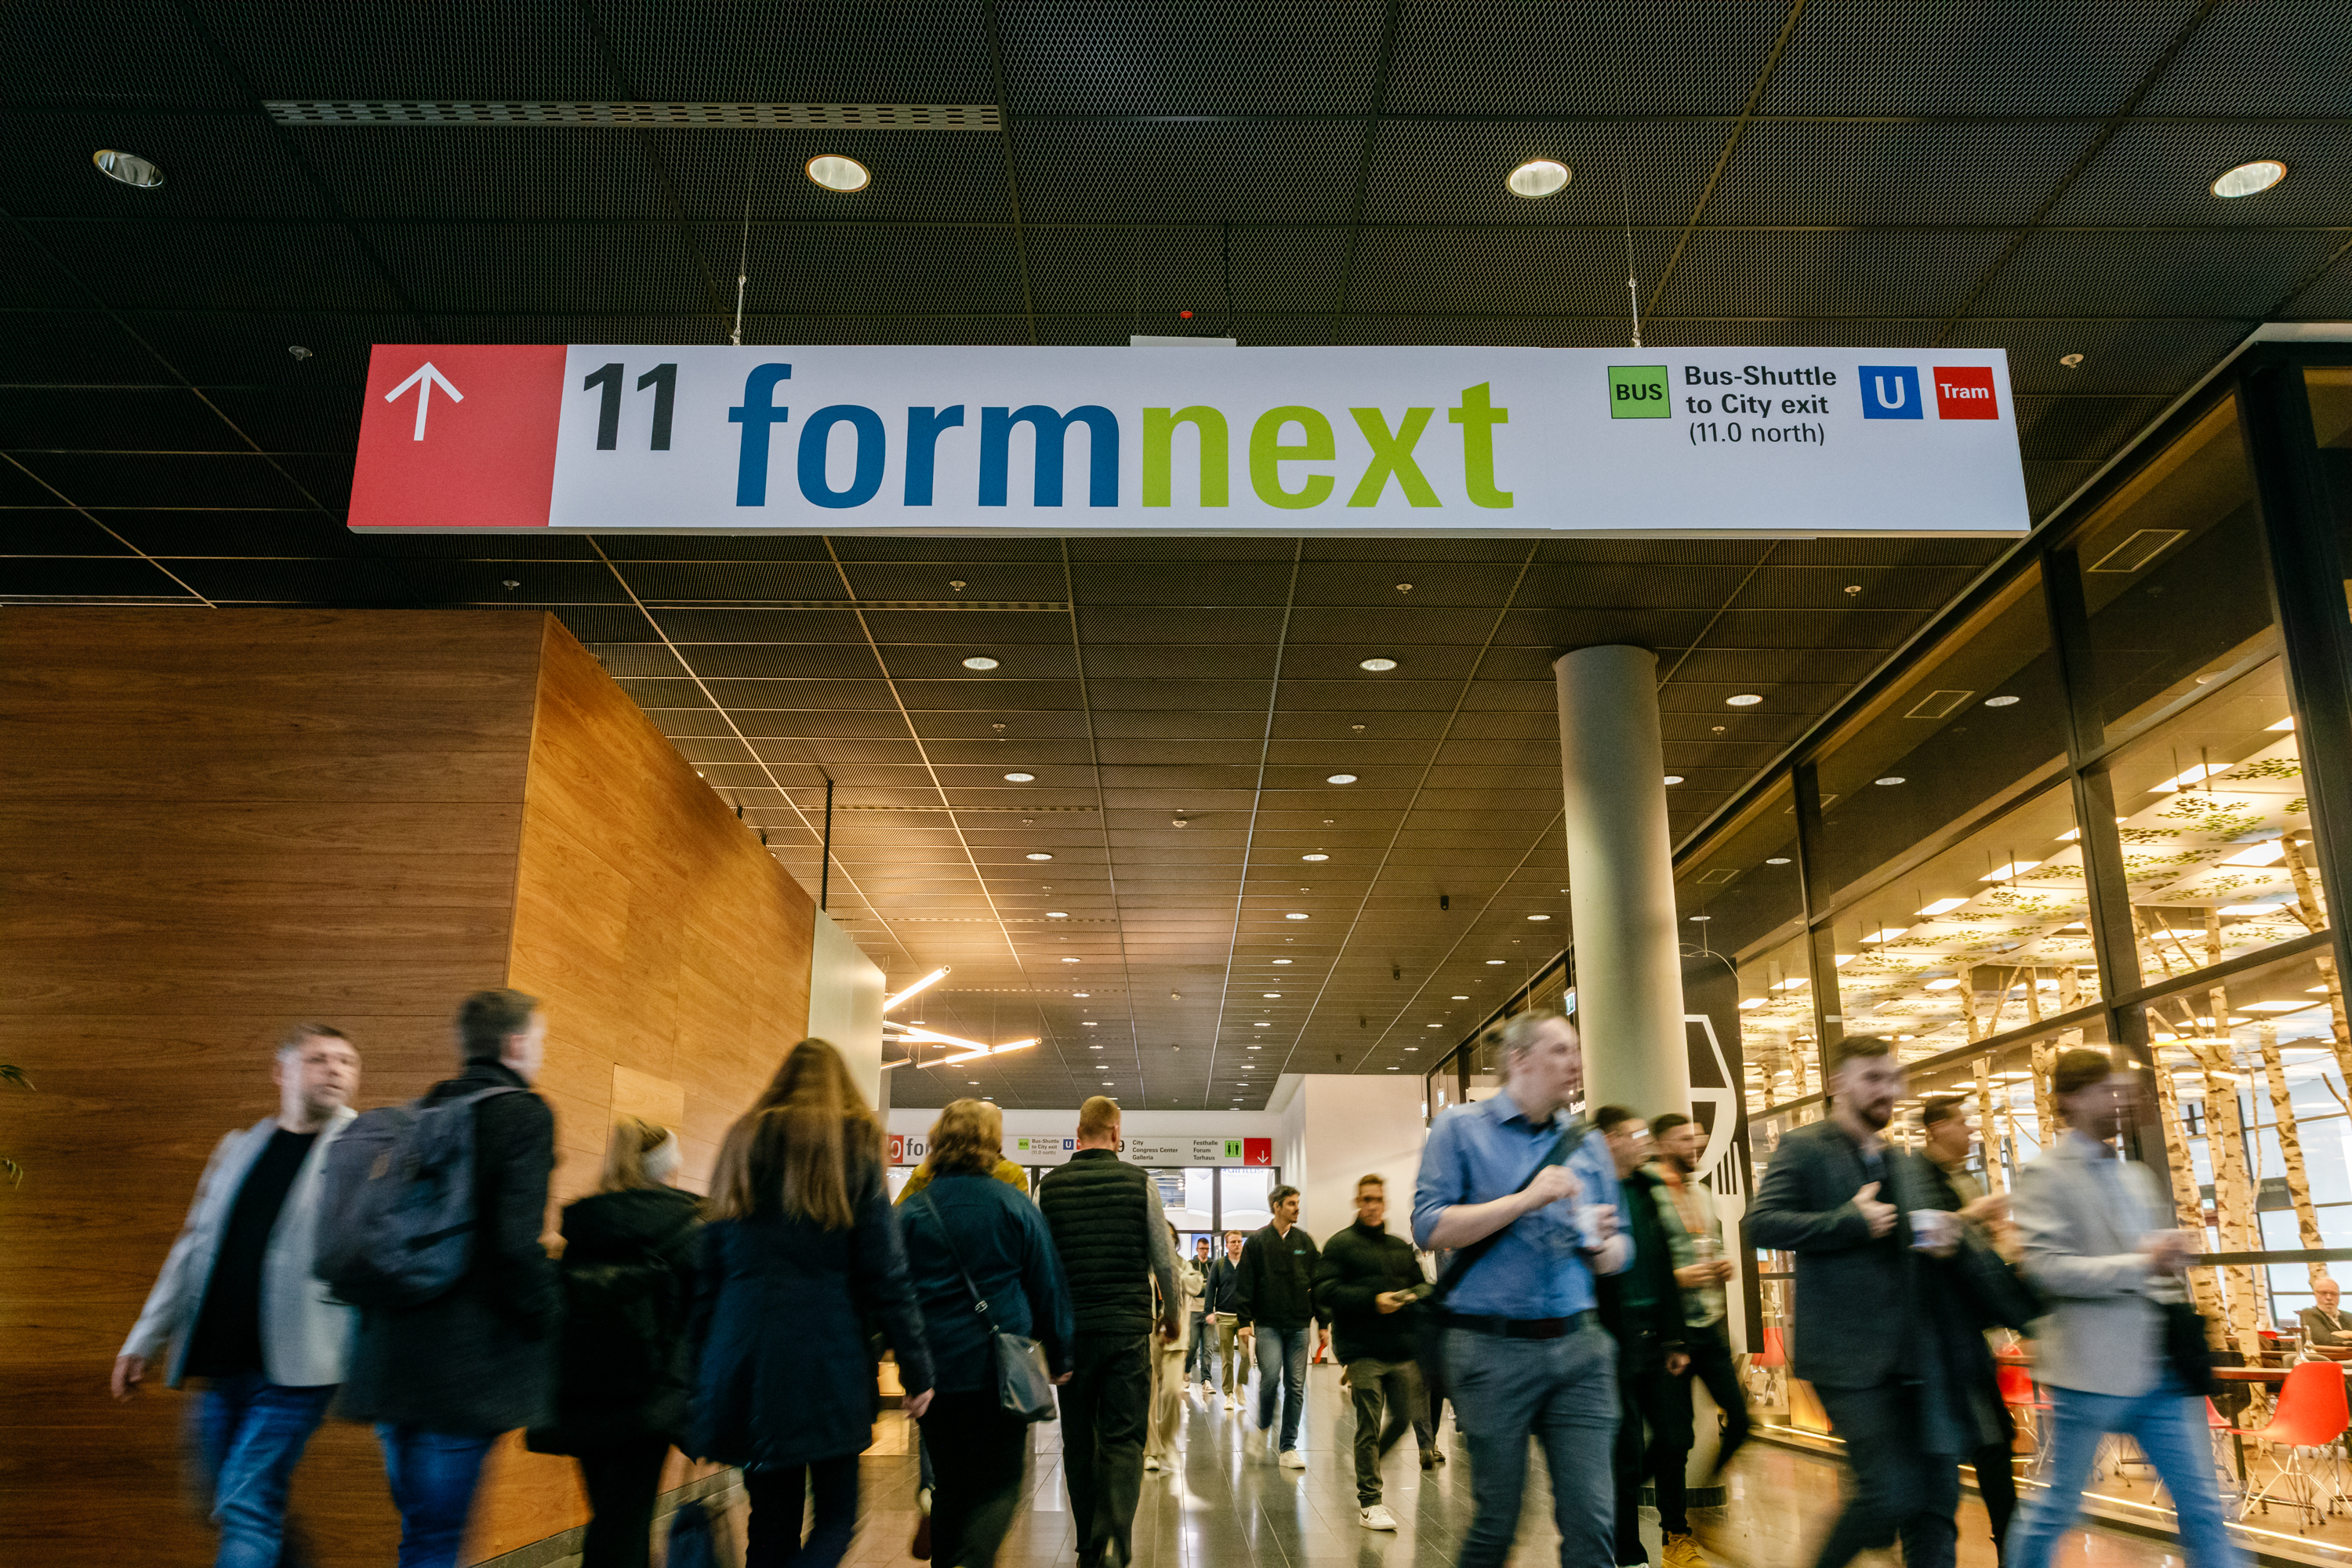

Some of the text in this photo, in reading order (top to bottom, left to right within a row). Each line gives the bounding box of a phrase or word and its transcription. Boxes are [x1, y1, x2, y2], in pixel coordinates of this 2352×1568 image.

[1685, 365, 1837, 386] Bus-Shuttle
[1616, 383, 1663, 401] BUS
[1875, 376, 1906, 409] U
[1940, 383, 1989, 399] Tram
[1686, 394, 1829, 418] to City exit
[583, 363, 1514, 510] 11 formnext
[1690, 422, 1825, 446] (11.0 north)
[1570, 1100, 1585, 1116] Restaura
